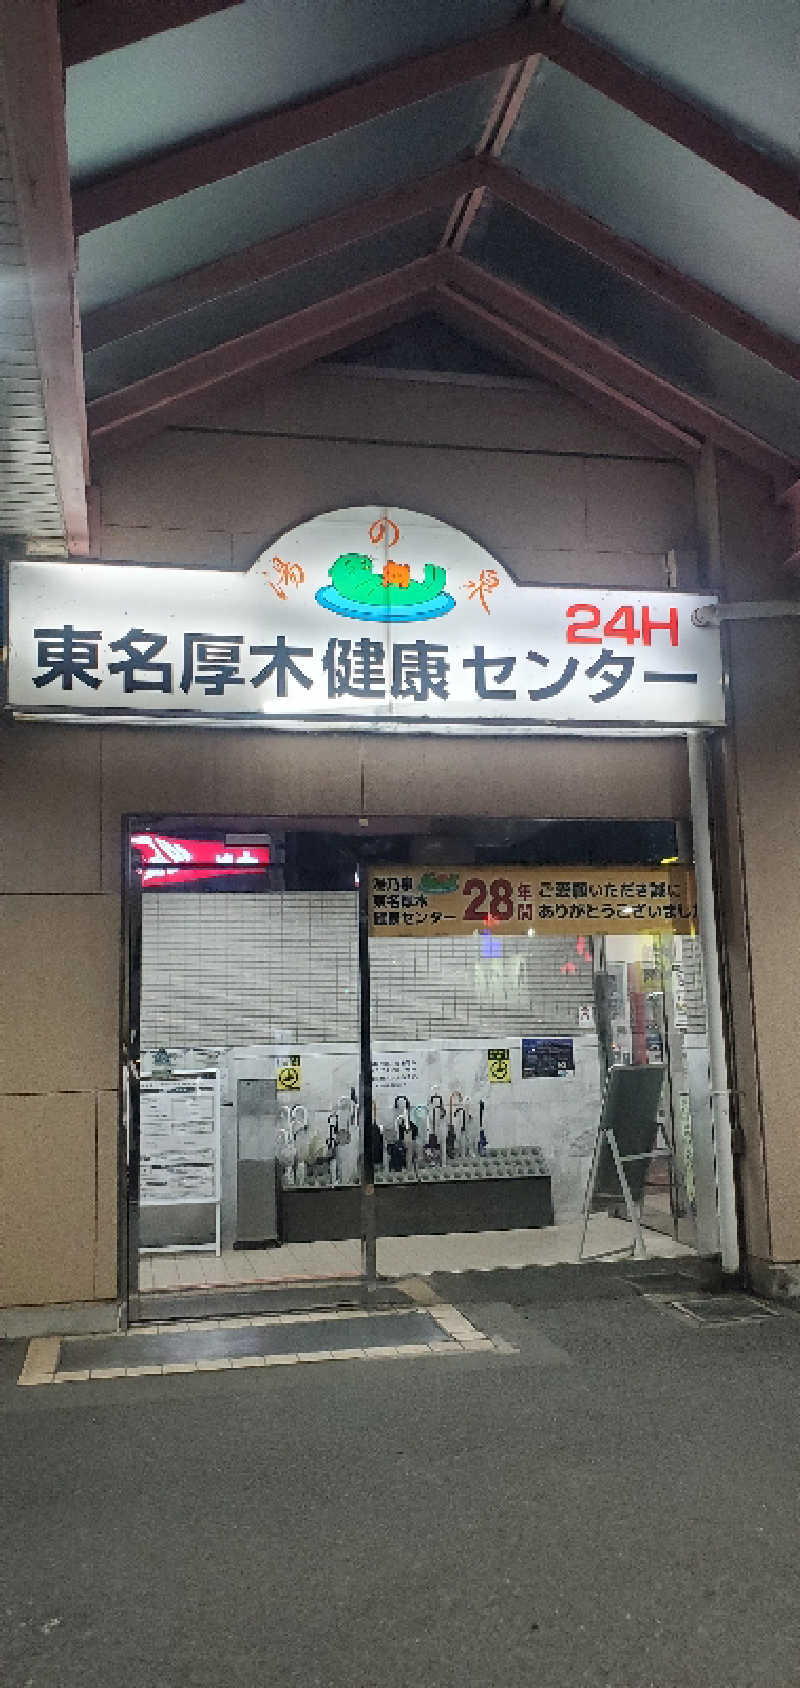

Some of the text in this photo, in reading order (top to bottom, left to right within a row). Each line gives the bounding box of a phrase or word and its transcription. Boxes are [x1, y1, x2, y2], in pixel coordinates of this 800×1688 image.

[565, 603, 679, 647] 24H
[32, 624, 698, 702] 東名厚木健康センター
[462, 878, 533, 921] 28 年間
[538, 903, 698, 919] ありがとうございまし
